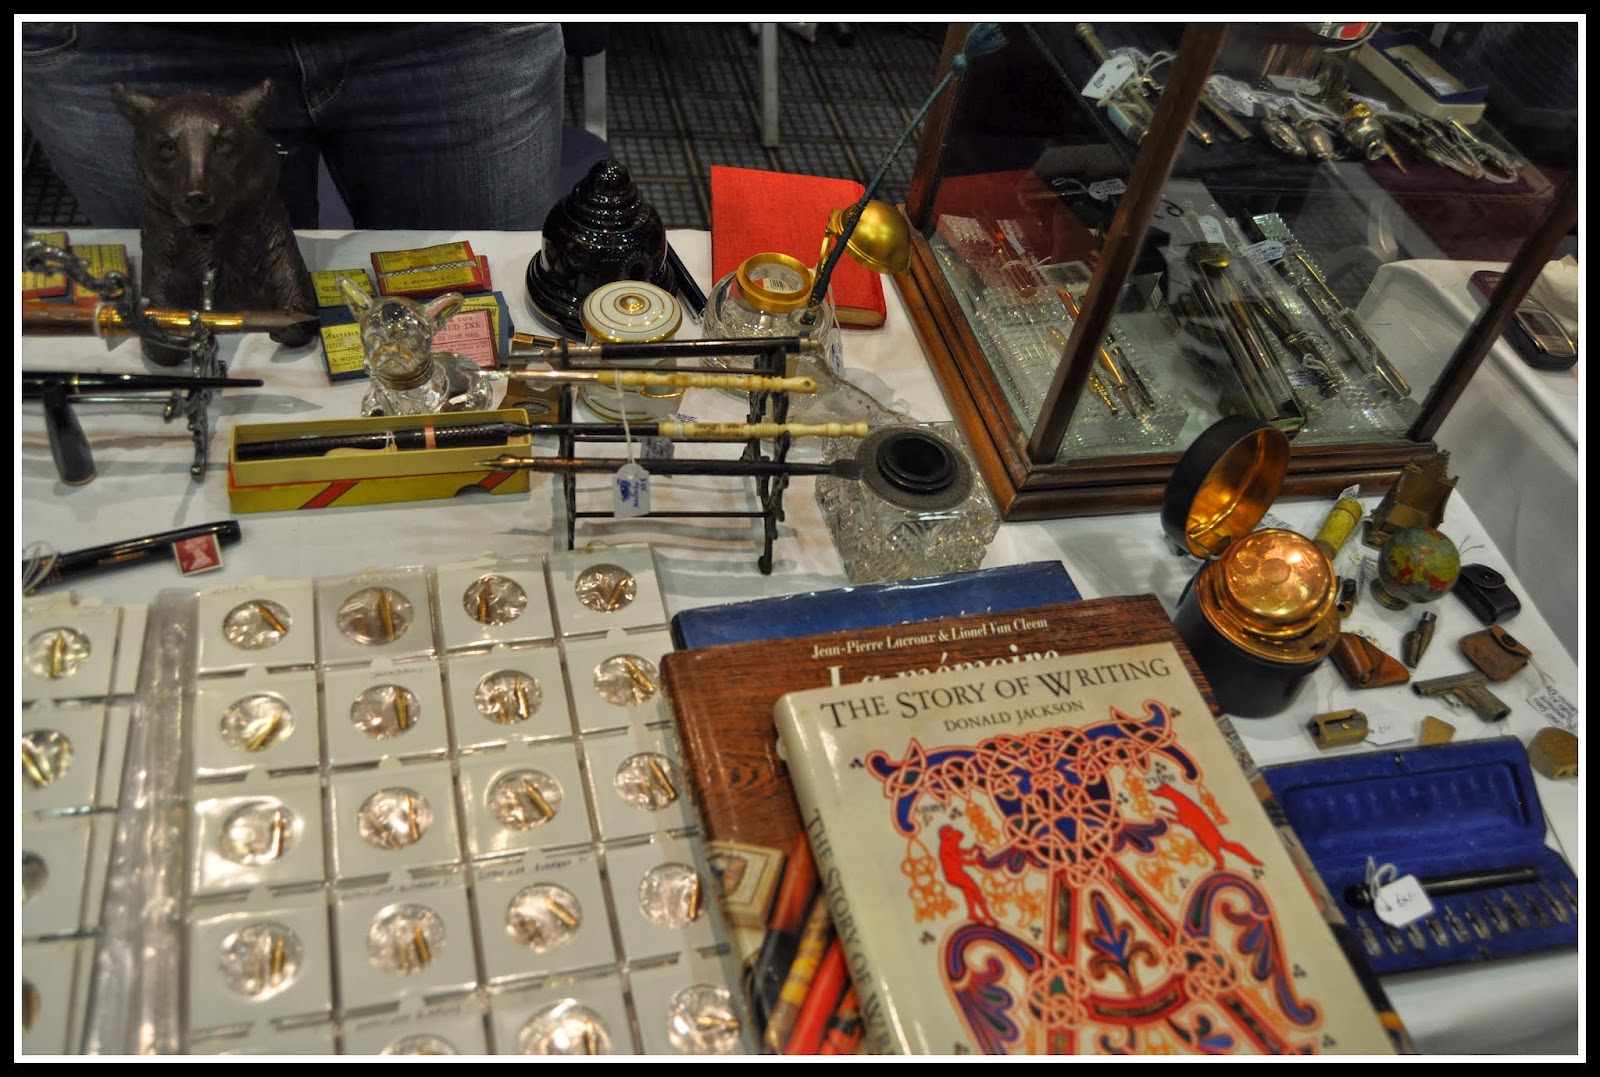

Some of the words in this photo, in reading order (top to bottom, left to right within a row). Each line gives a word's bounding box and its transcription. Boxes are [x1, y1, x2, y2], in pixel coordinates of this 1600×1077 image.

[811, 640, 884, 660] Jean-Pierre
[886, 632, 936, 650] Lacroux
[938, 629, 950, 643] &
[951, 622, 989, 640] Lionel
[989, 619, 1012, 637] Van
[1012, 617, 1049, 633] Cleem
[820, 696, 890, 730] THE
[896, 681, 987, 720] STORY
[994, 675, 1032, 700] OF
[1036, 657, 1172, 699] WRITING
[944, 711, 1013, 733] DONALD
[1016, 699, 1085, 726] JACKSON
[807, 808, 834, 859] THE
[826, 866, 862, 946] STORY
[853, 952, 875, 986] OF
